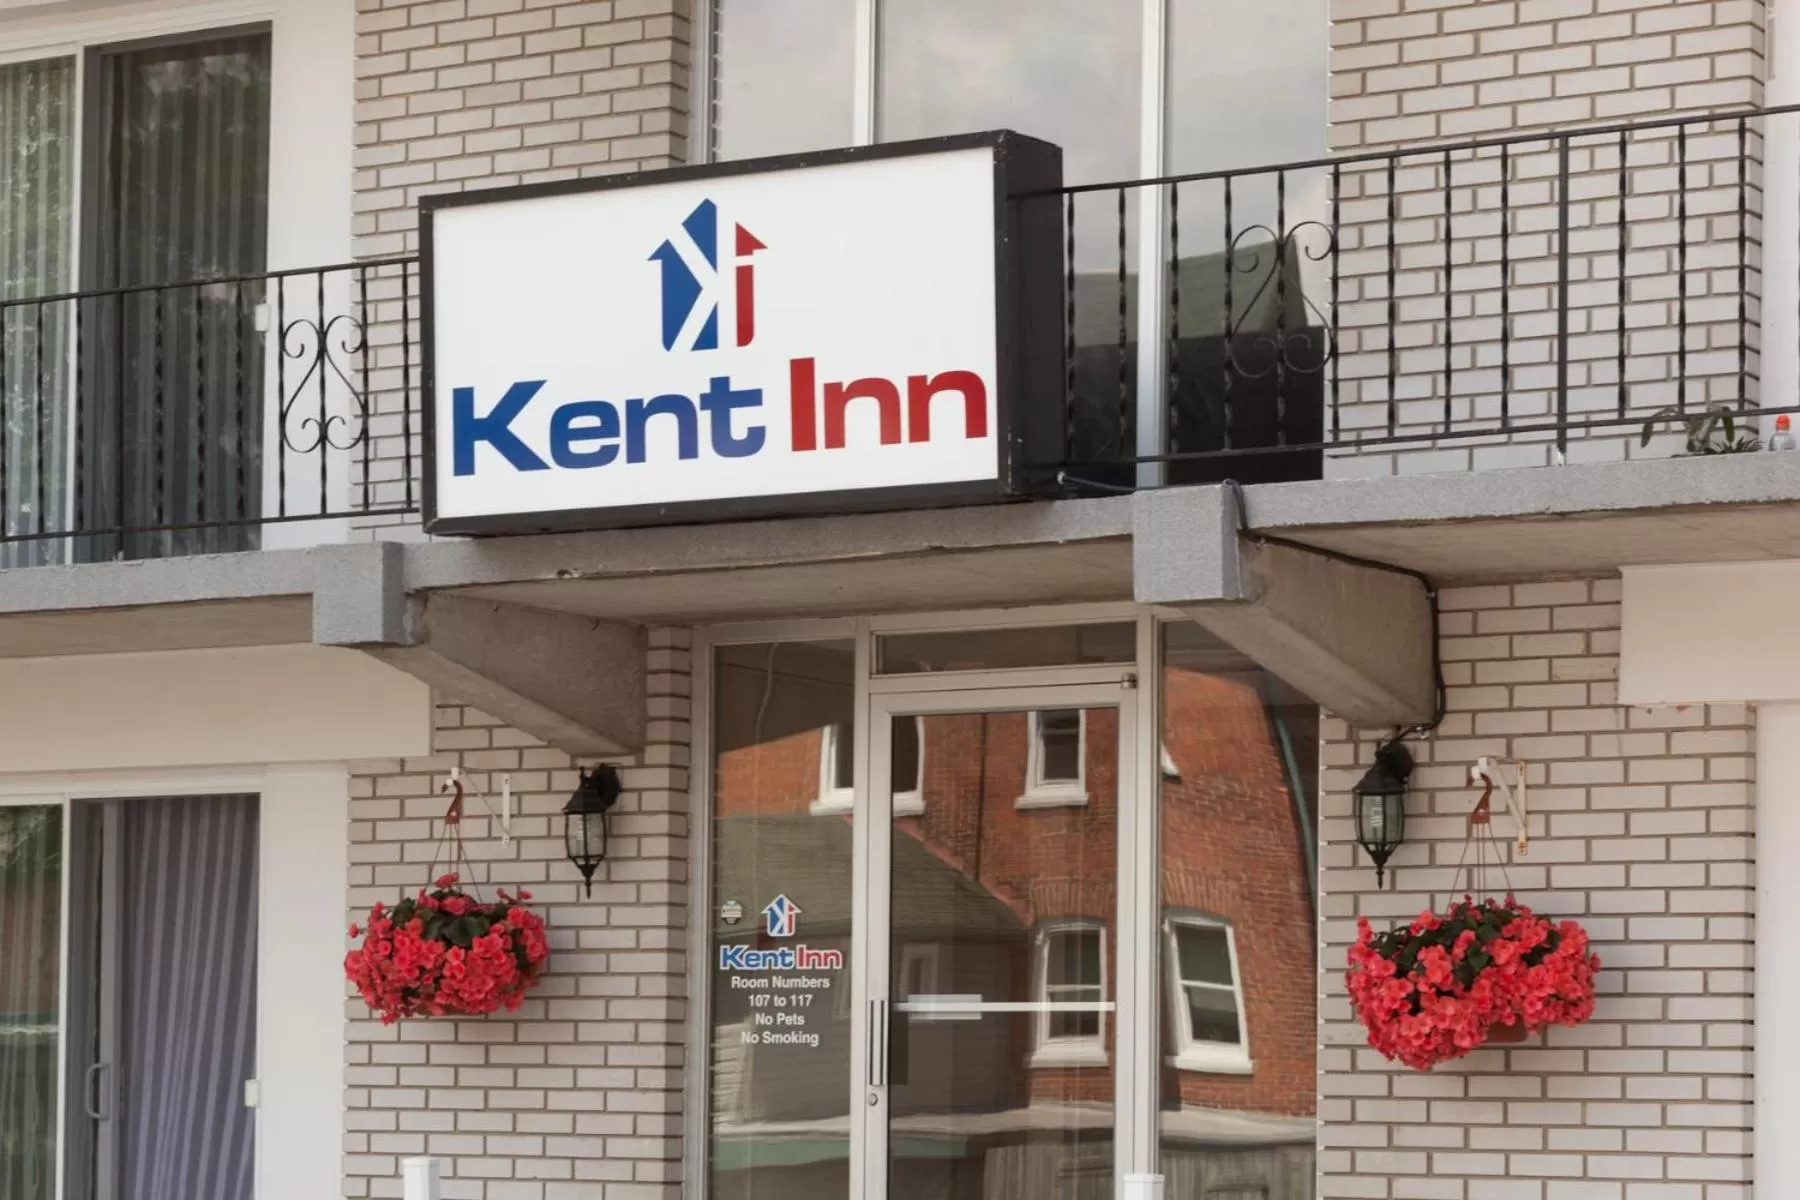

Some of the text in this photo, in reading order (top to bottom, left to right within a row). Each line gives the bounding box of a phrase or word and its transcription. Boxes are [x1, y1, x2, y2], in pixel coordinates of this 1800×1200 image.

[452, 357, 988, 476] Kent Inn
[720, 944, 843, 970] Kent Inn
[731, 976, 830, 989] Room Numbers
[748, 995, 813, 1007] 107 to 117
[755, 1013, 805, 1025] No Pets
[741, 1031, 819, 1047] No Smoking
